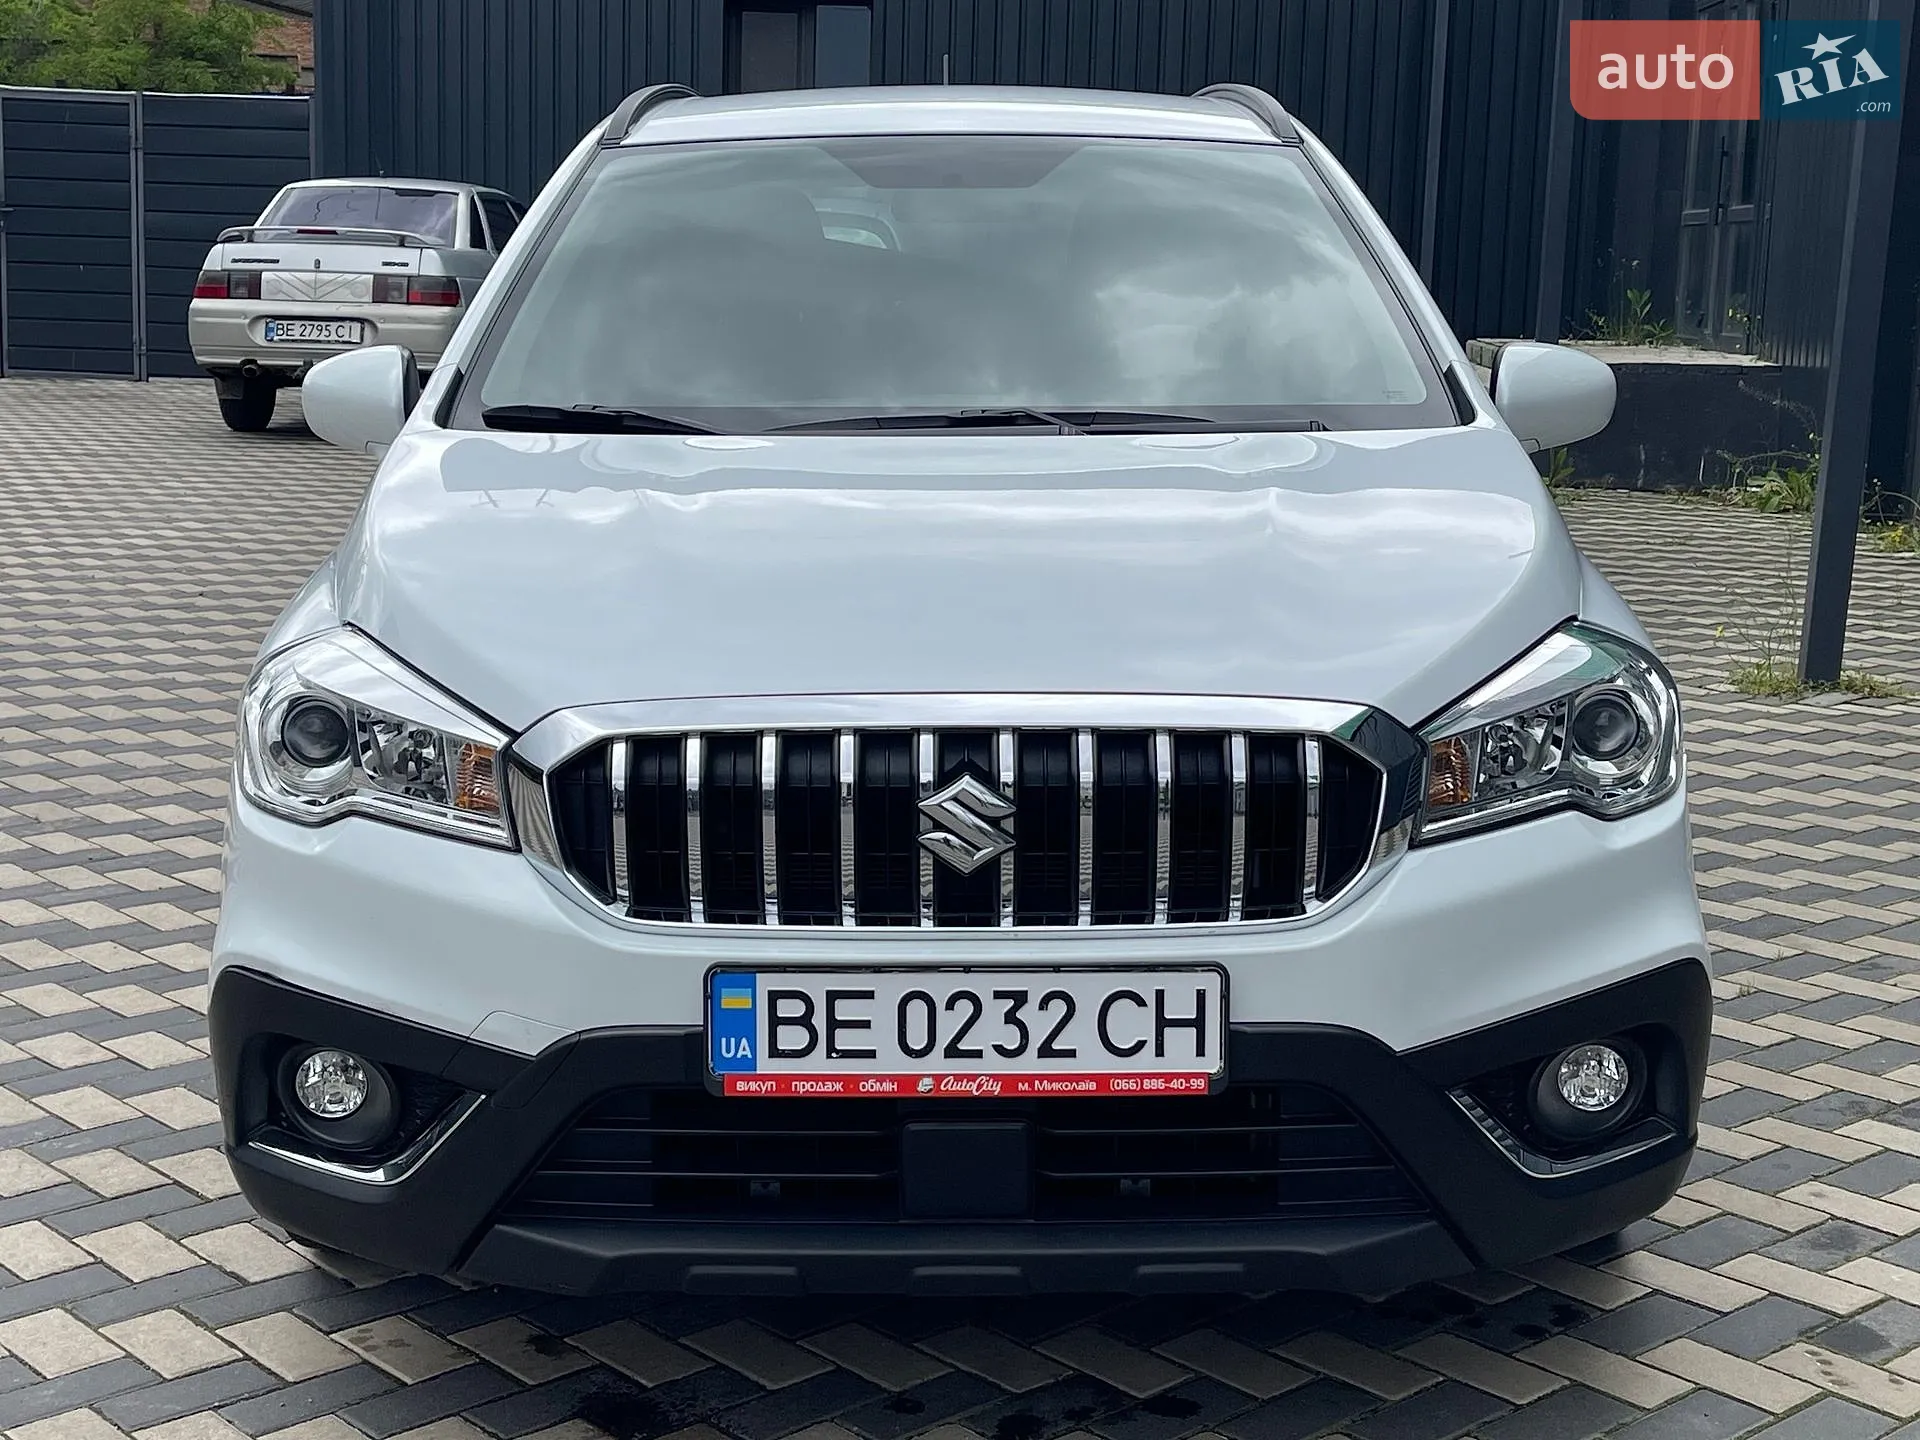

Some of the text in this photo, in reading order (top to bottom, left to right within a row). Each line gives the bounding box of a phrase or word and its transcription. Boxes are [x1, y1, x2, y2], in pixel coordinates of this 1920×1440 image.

[275, 323, 296, 337] BE
[299, 323, 332, 338] 2795
[767, 988, 1206, 1059] BE 0232 CH
[720, 1037, 753, 1059] UA
[859, 1077, 898, 1092] обмін
[1109, 1078, 1141, 1091] (066)
